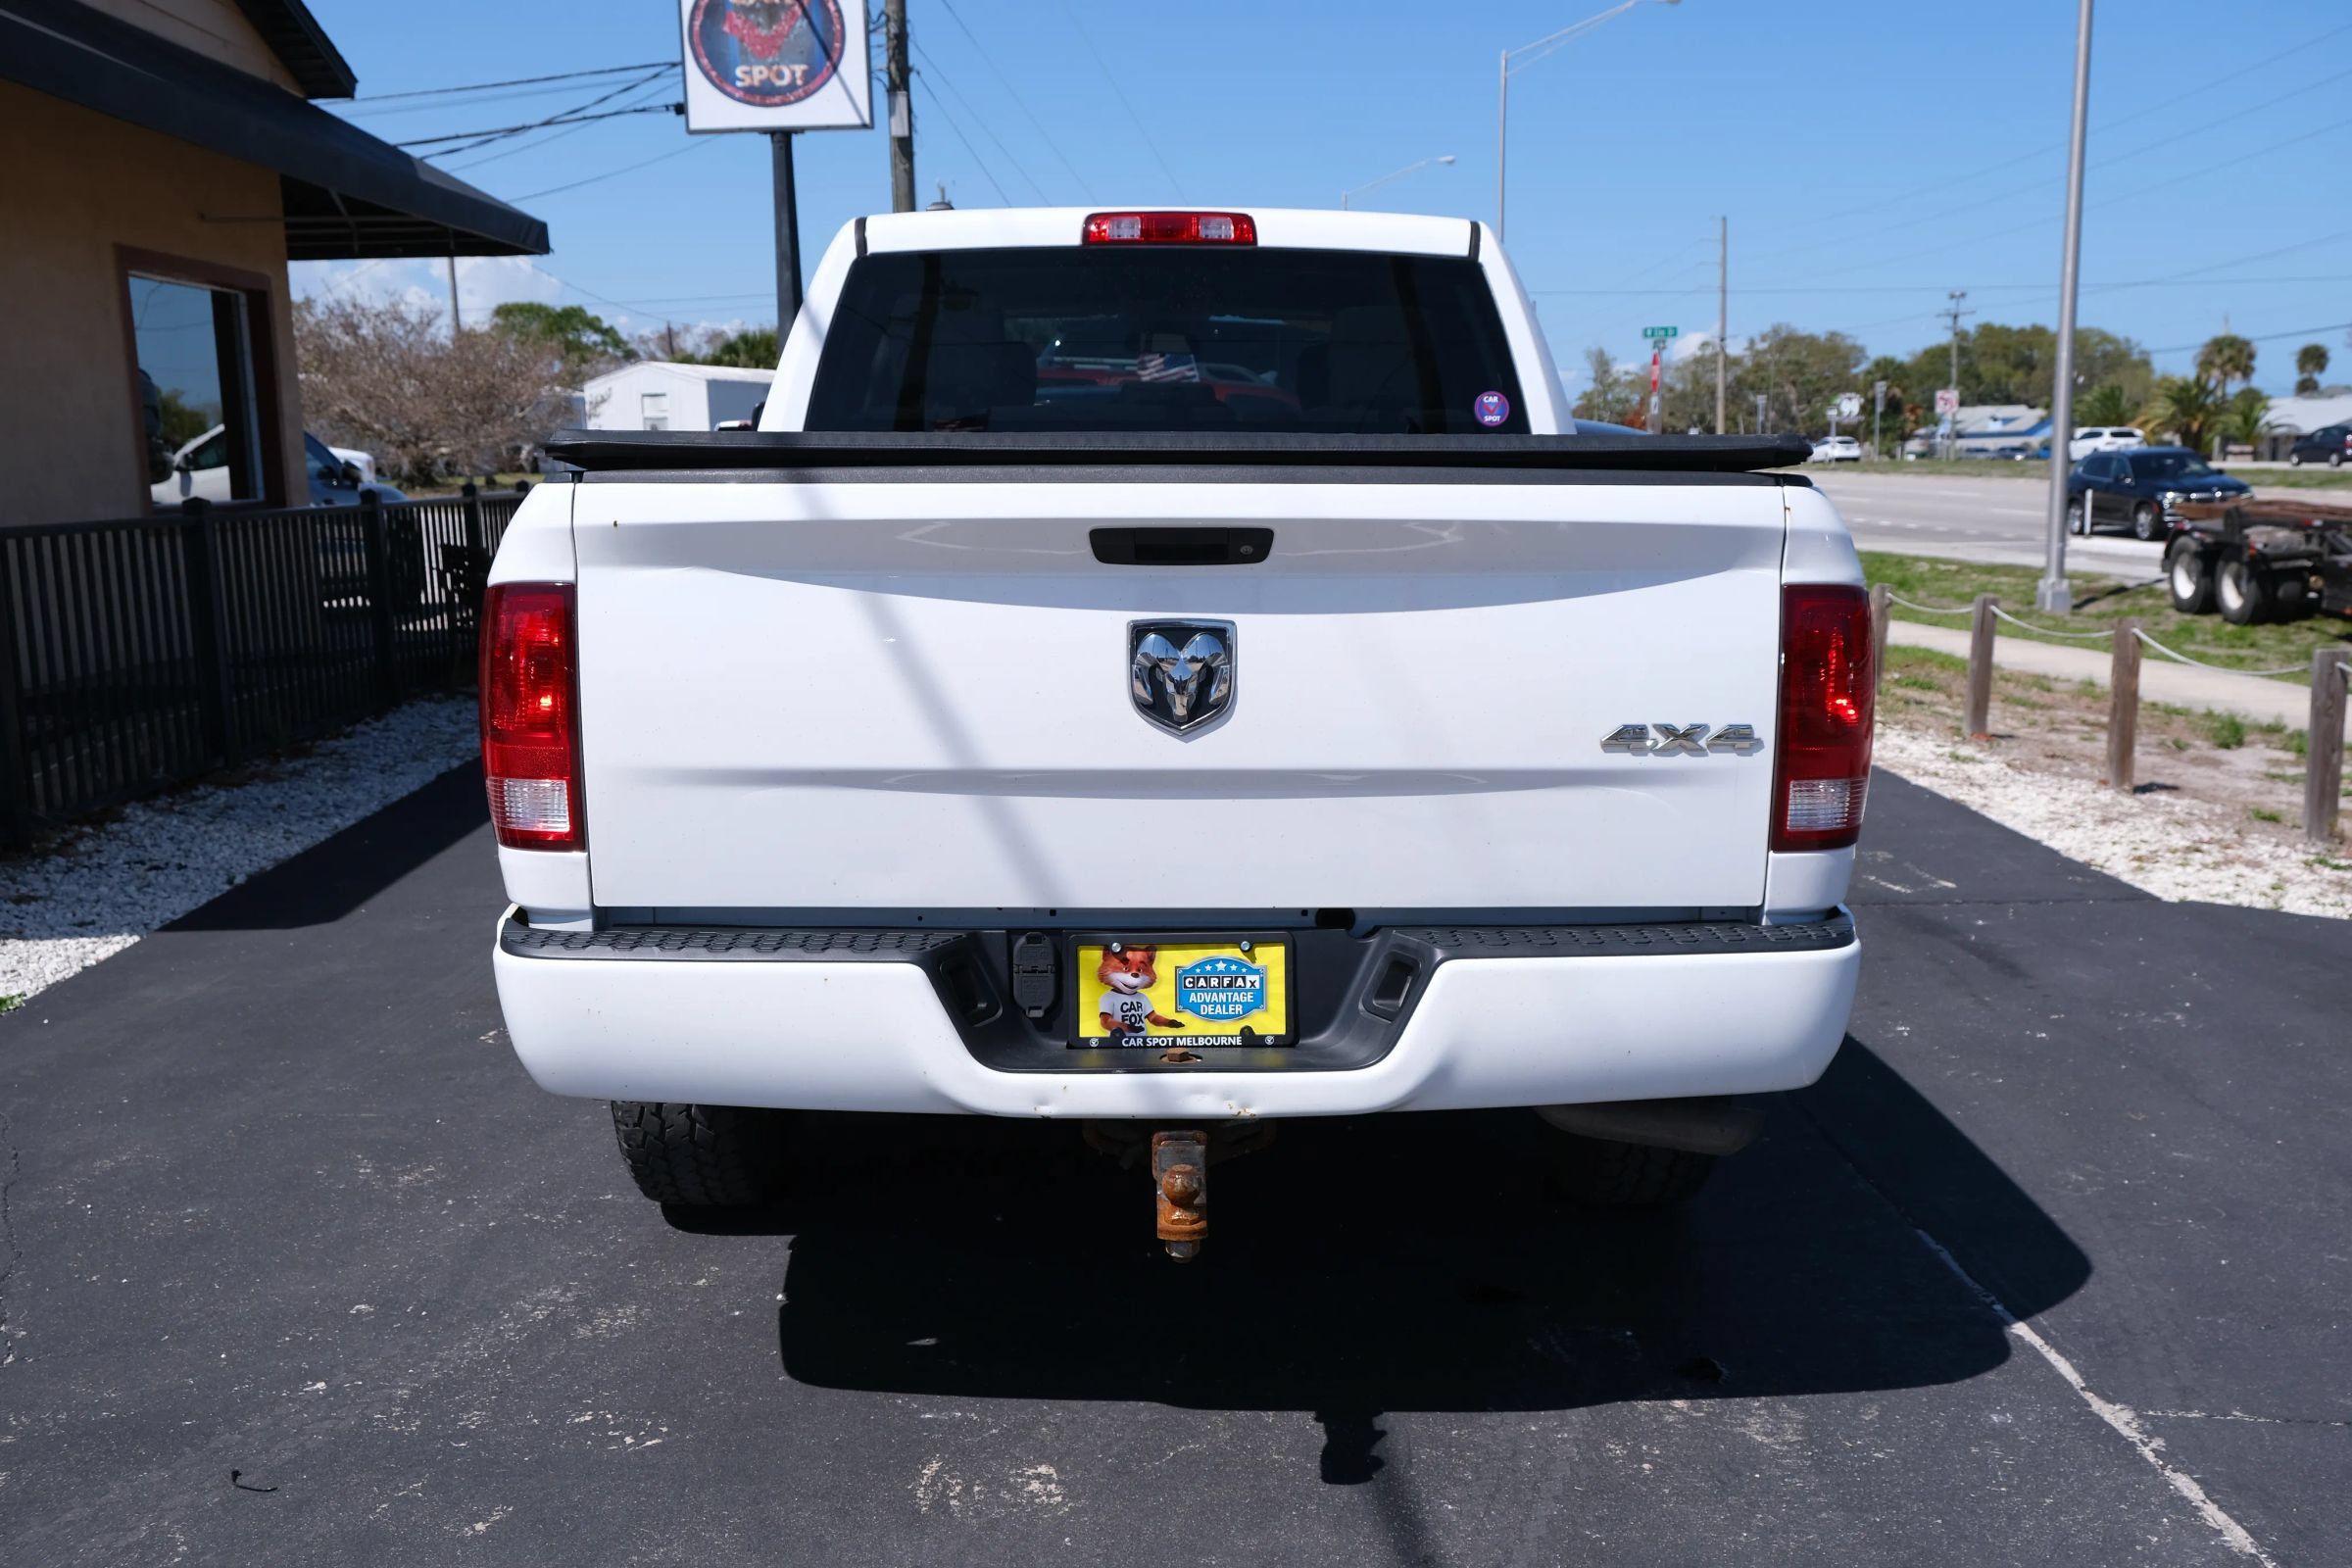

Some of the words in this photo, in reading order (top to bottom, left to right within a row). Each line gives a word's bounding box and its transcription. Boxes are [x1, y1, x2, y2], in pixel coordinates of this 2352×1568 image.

[735, 64, 809, 87] SPOT
[1600, 723, 1762, 754] 4X4
[1189, 992, 1254, 1004] ADVANTAGE
[1120, 1002, 1144, 1013] CAR
[1200, 1004, 1243, 1015] DEALER
[1121, 1014, 1144, 1026] FOX
[1121, 1038, 1143, 1048] CAR
[1146, 1037, 1174, 1047] SPOT
[1176, 1036, 1243, 1047] MELBOURNE
